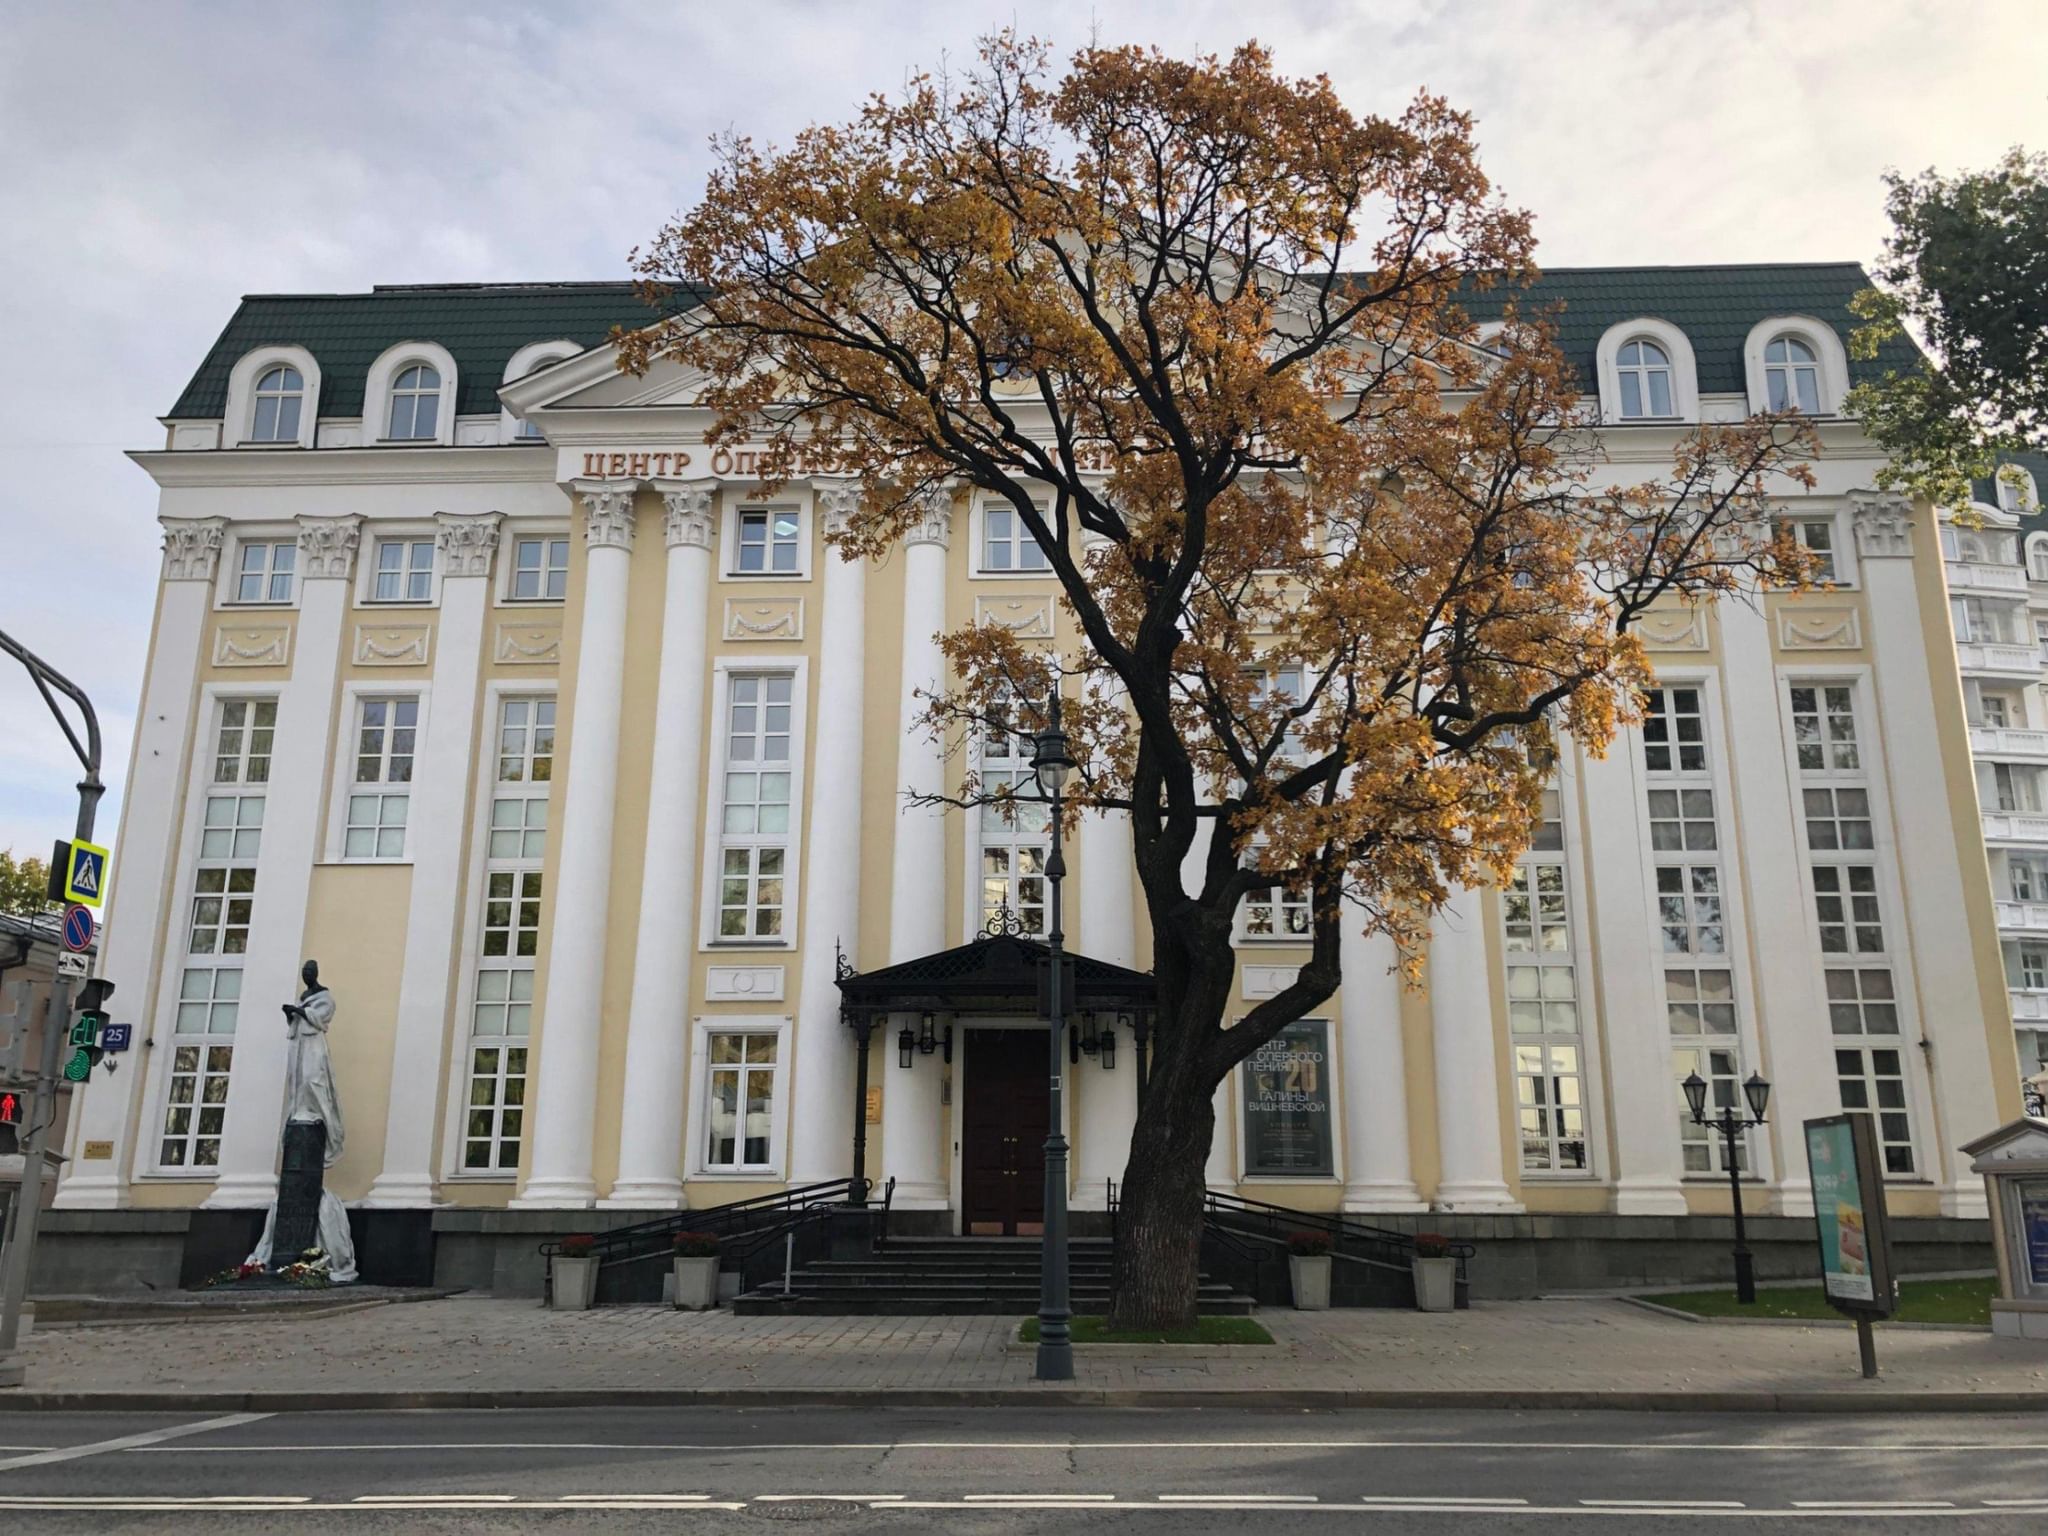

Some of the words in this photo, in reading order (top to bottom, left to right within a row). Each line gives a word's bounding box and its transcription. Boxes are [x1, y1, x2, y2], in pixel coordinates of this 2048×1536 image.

[583, 452, 691, 479] ЦЕНТР
[72, 1016, 97, 1045] 20
[106, 1028, 124, 1042] 25
[1256, 1051, 1323, 1062] ОПЕРНОГО
[1247, 1062, 1289, 1072] ПЕНИЯ
[1285, 1060, 1317, 1092] 20
[1259, 1091, 1309, 1102] ГАЛИНЫ
[1248, 1101, 1326, 1112] ВИШНЕВСКОЙ
